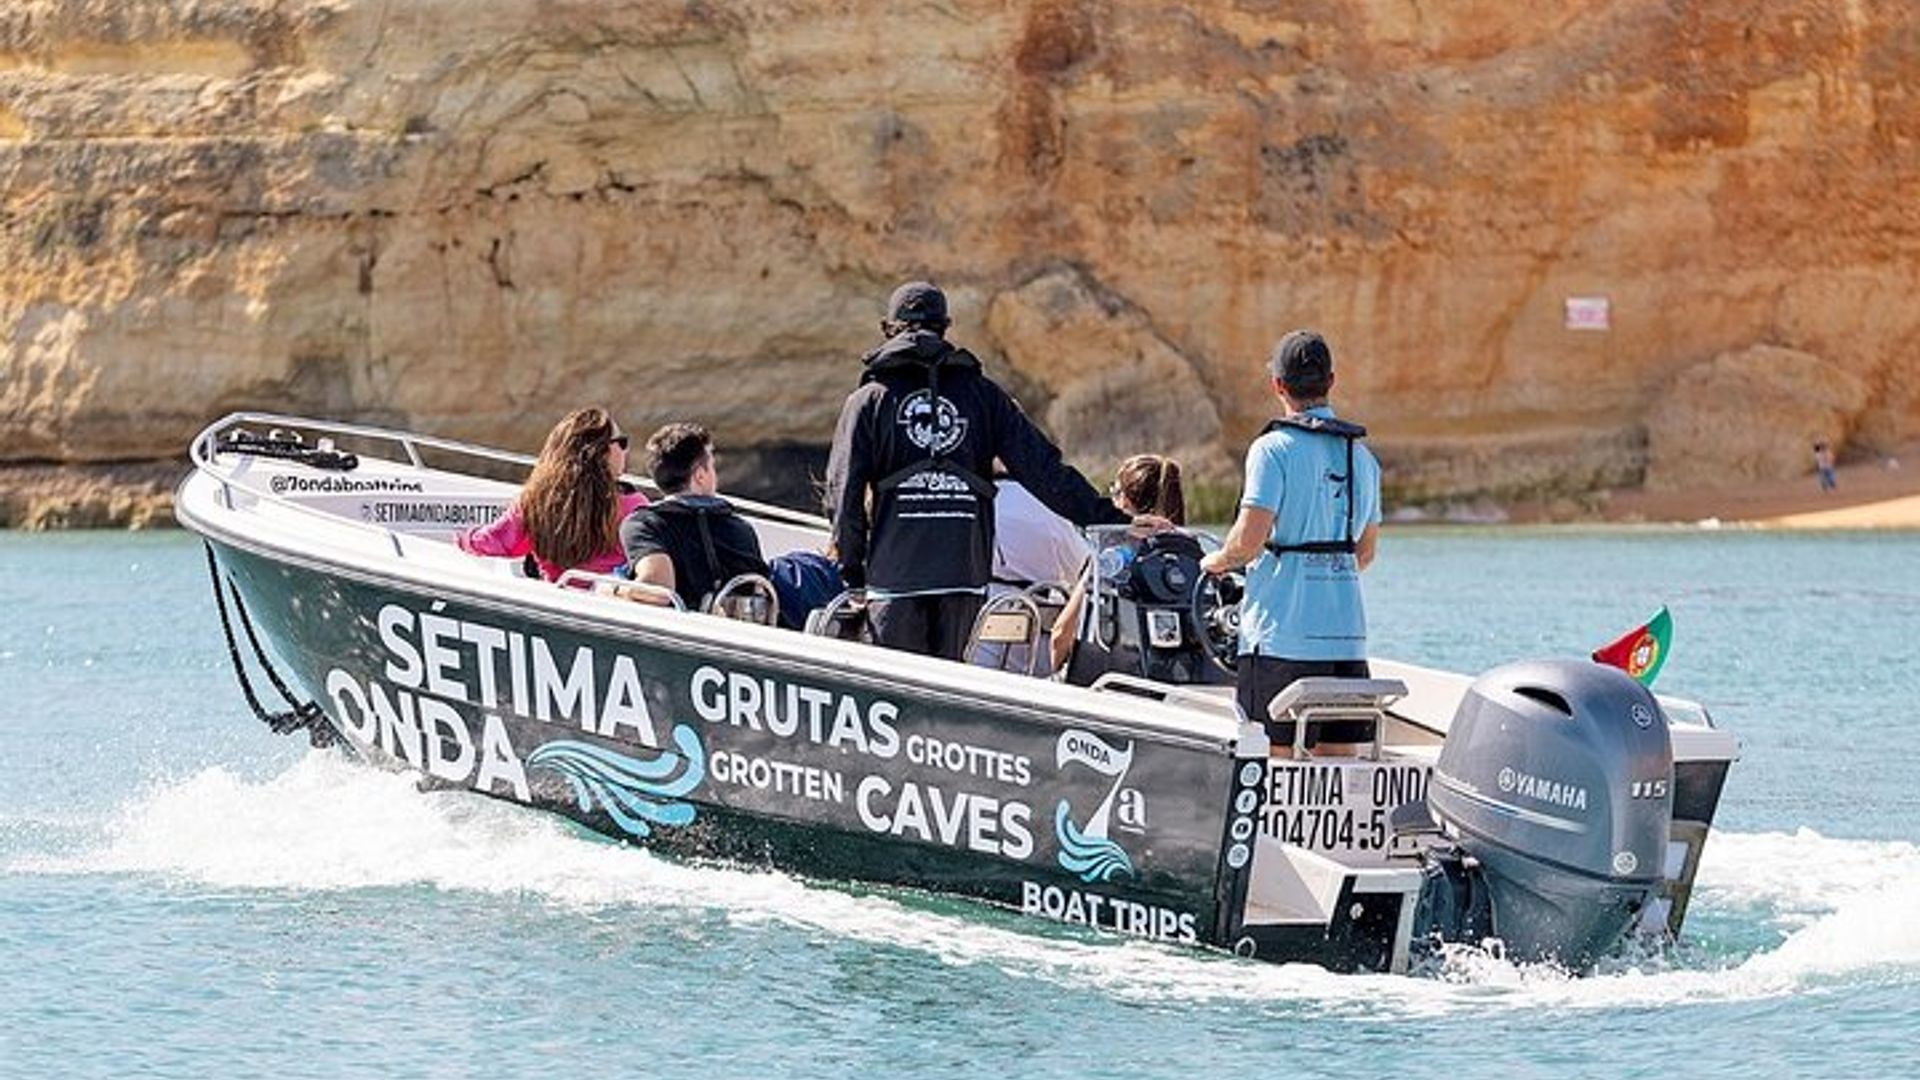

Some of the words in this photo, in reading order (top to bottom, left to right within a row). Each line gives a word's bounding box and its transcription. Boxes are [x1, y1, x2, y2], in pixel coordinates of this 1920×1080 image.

[378, 600, 658, 748] SÉTIMA
[325, 667, 533, 803] ONDA
[690, 665, 900, 759] GRUTAS
[906, 733, 1032, 787] GROTTES
[1065, 736, 1112, 768] ONDA
[709, 750, 844, 804] GROTTEN
[855, 775, 1035, 861] CAVES
[1516, 774, 1588, 811] YAMAHA
[1630, 779, 1667, 799] 115
[1022, 881, 1104, 930] BOAT
[1109, 897, 1197, 944] TRIPS
